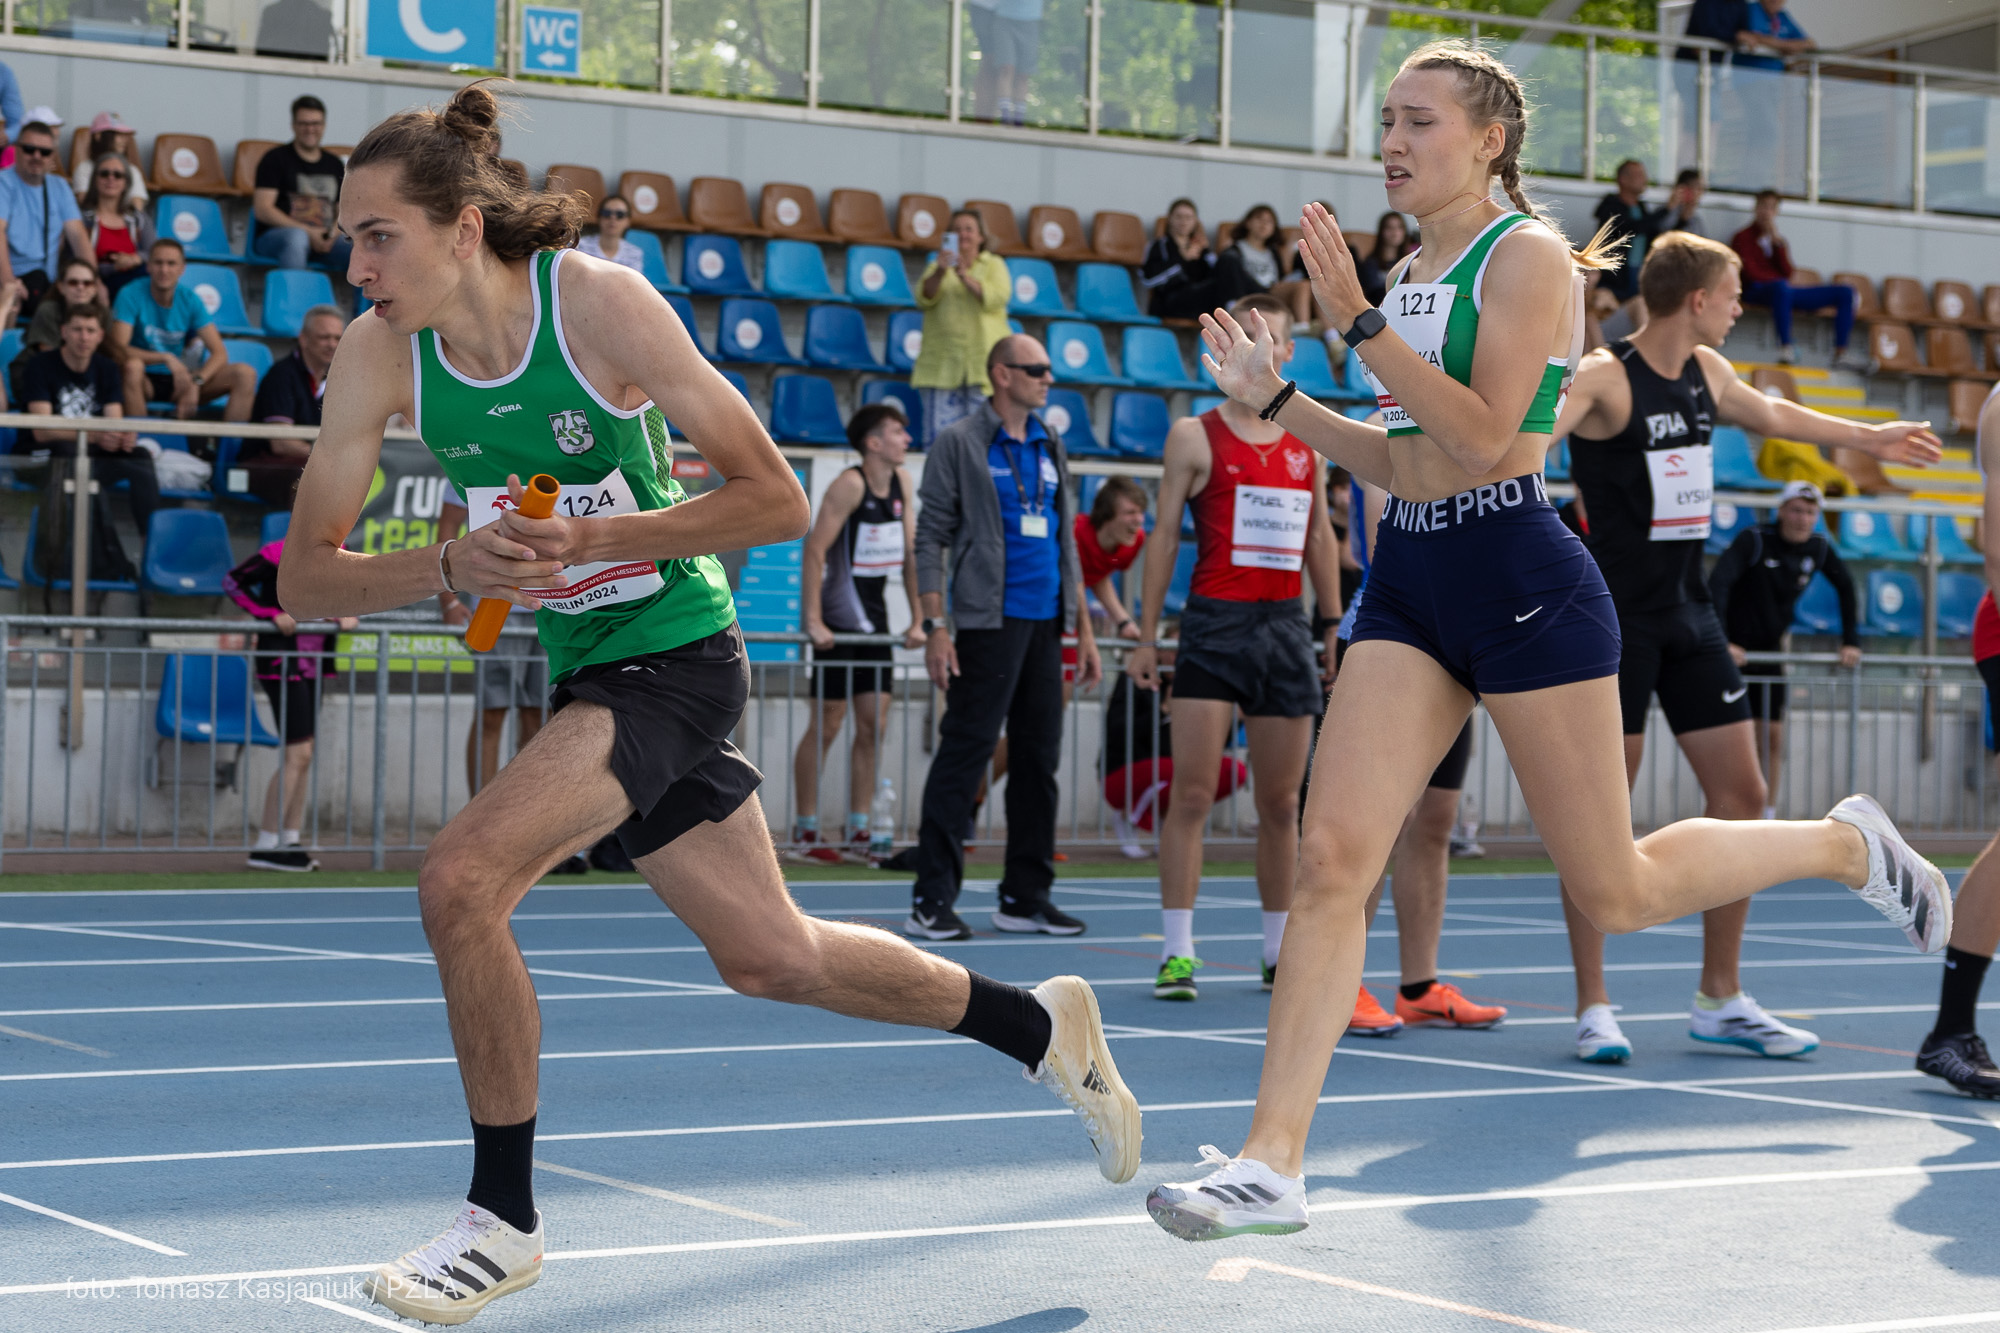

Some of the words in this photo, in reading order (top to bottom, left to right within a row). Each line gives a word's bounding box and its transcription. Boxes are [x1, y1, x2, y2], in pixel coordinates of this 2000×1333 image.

[528, 15, 577, 48] WC
[1400, 292, 1436, 317] 121
[1389, 410, 1410, 422] 202
[562, 488, 616, 517] 124
[1393, 498, 1448, 533] NIKE
[1455, 478, 1523, 525] PRO
[579, 571, 617, 589] SZTAFETACH
[617, 565, 652, 576] MIESZANYCH
[585, 584, 619, 603] 2024
